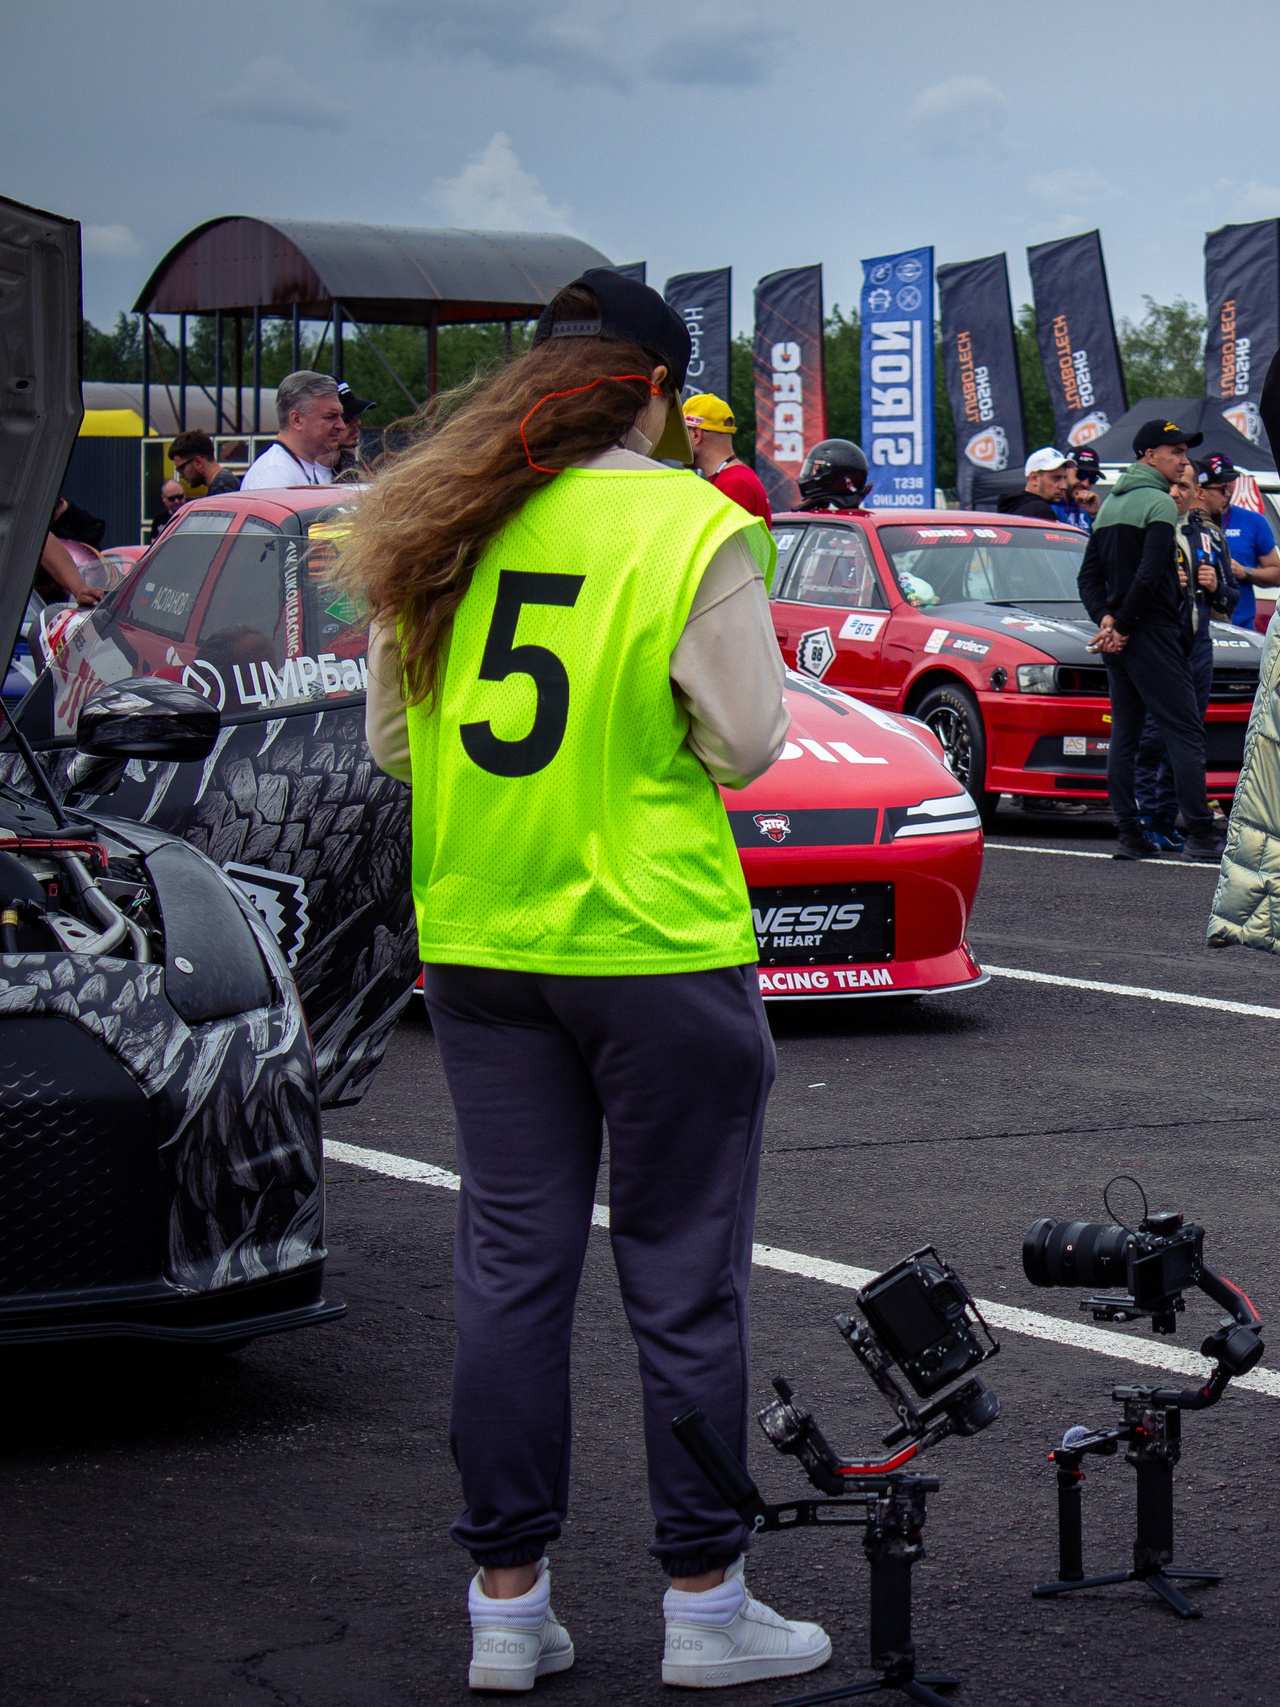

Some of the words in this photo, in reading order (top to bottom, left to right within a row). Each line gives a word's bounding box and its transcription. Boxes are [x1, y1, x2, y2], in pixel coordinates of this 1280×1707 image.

[855, 623, 874, 636] ВТБ
[811, 646, 823, 662] 88
[953, 639, 990, 655] ardeca
[459, 568, 587, 778] 5
[773, 934, 823, 948] HEART
[834, 968, 893, 987] TEAM
[476, 1639, 526, 1655] adidas
